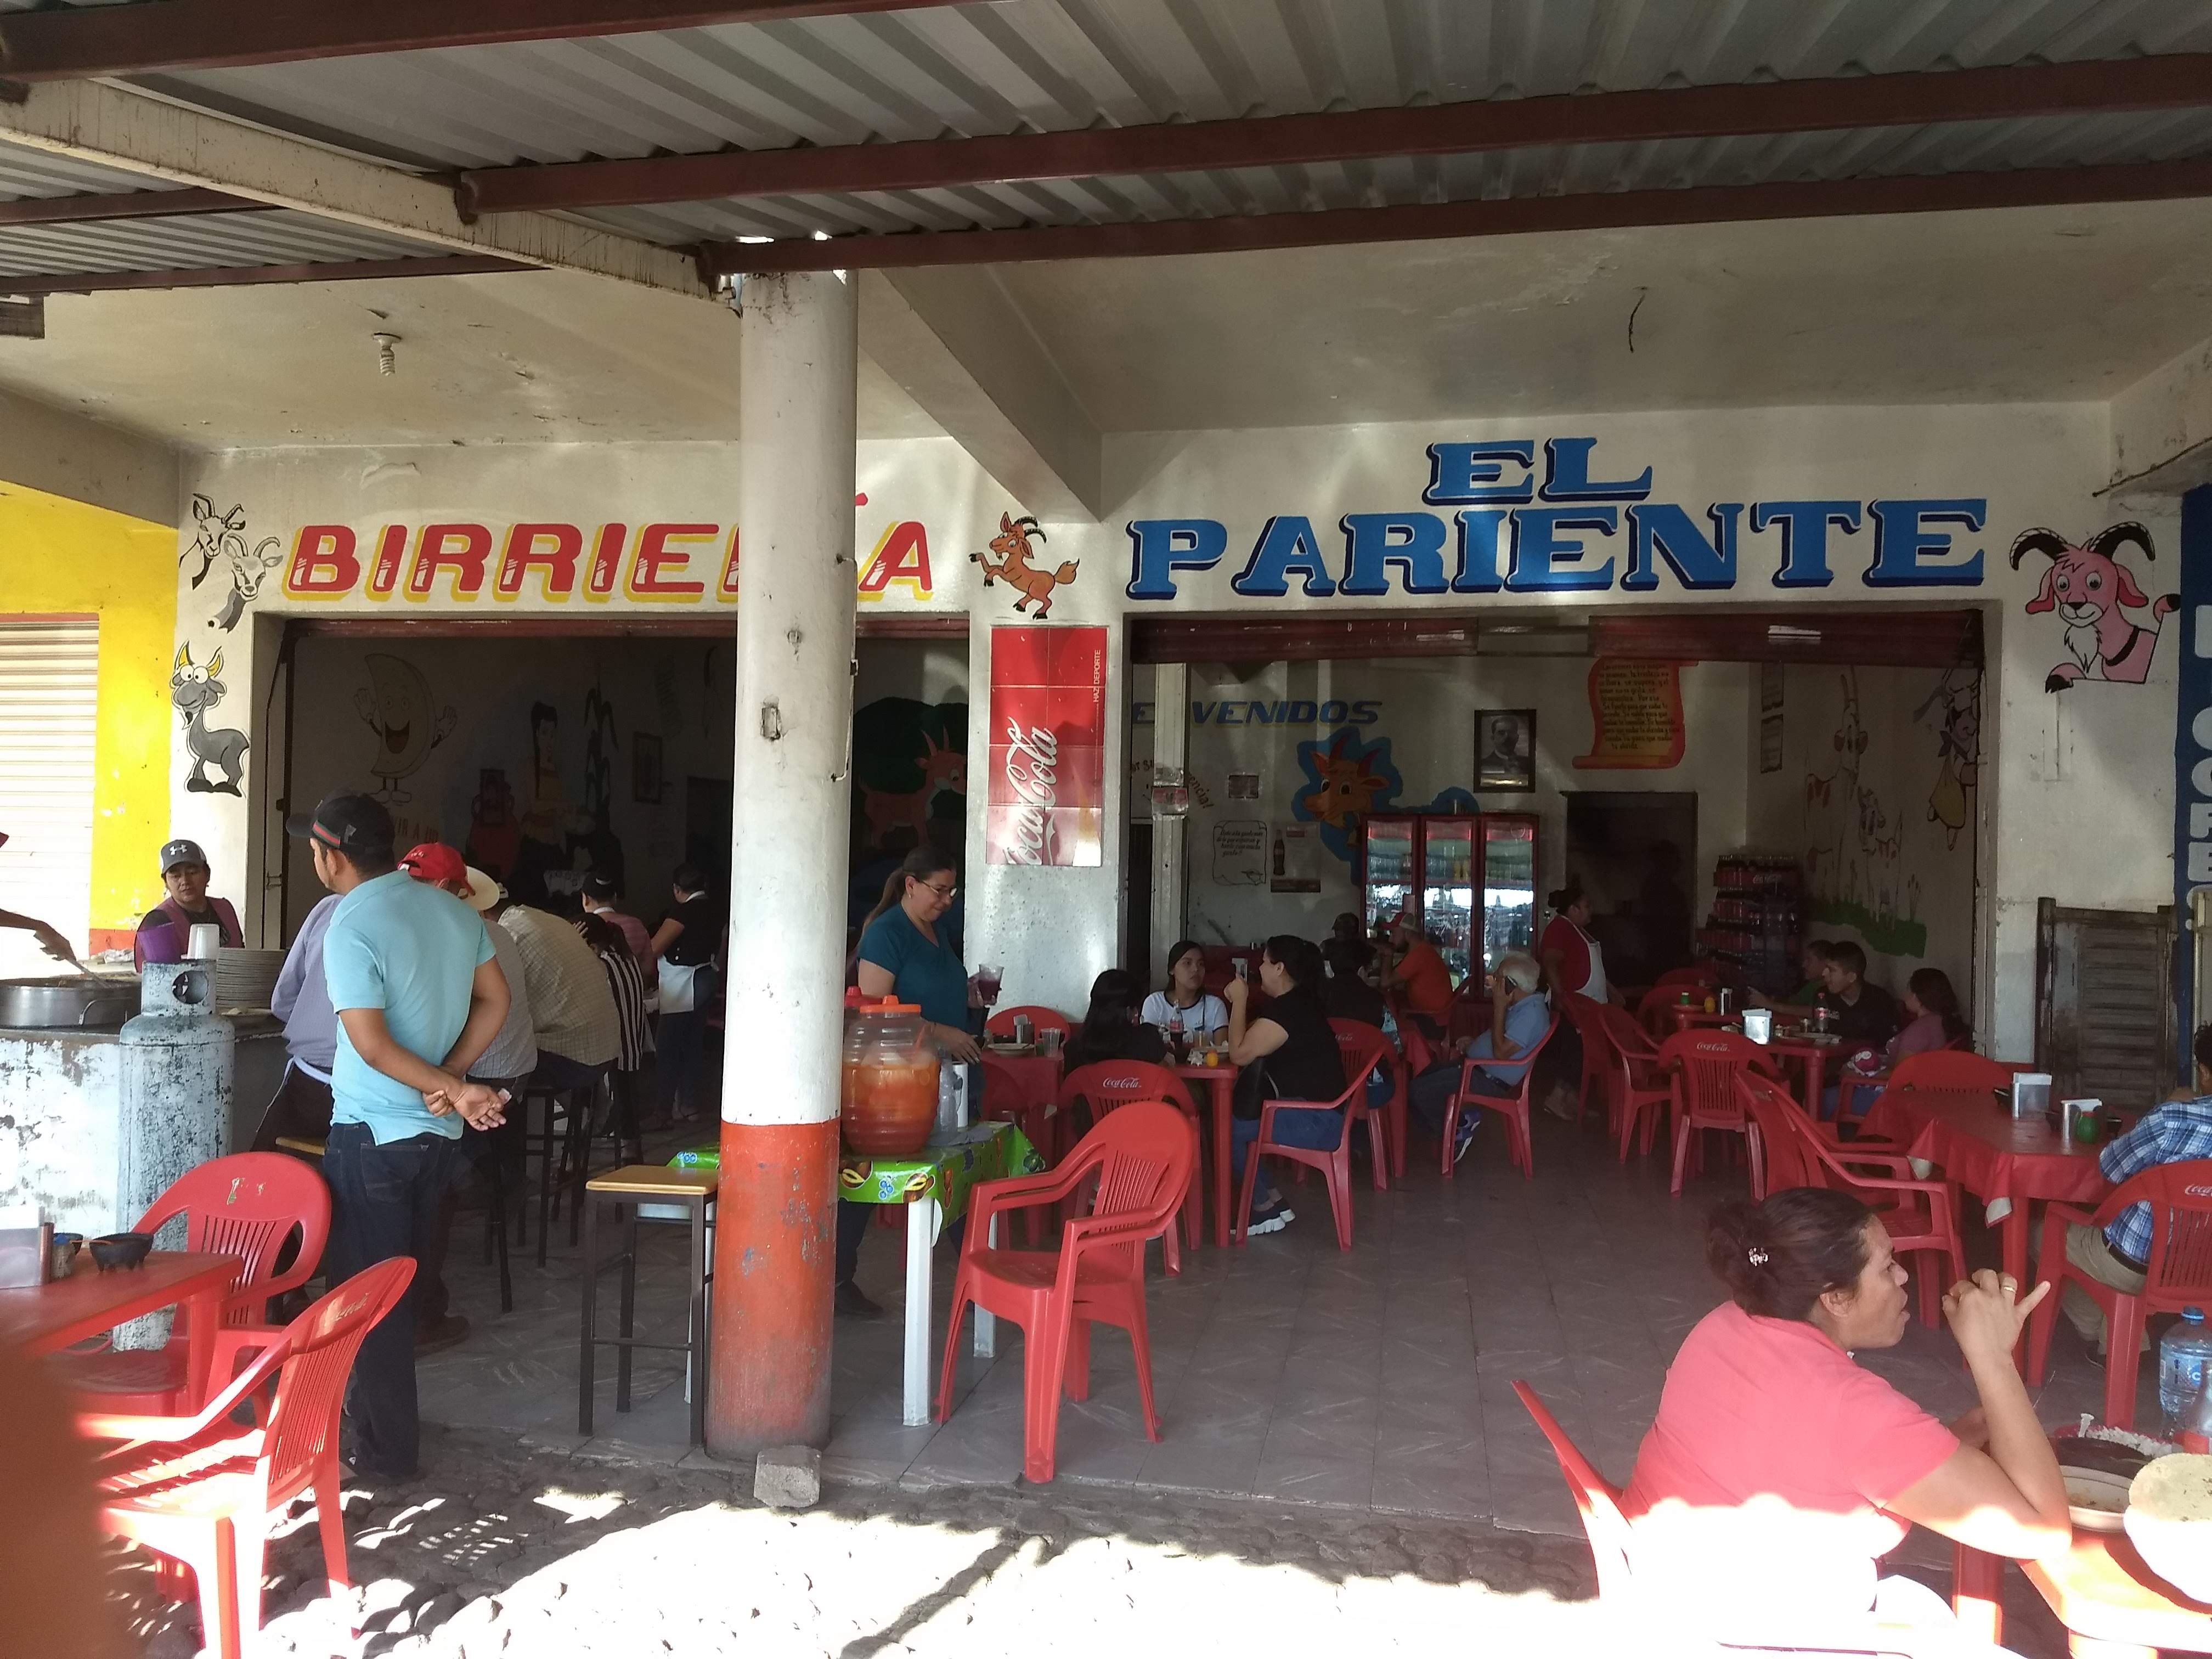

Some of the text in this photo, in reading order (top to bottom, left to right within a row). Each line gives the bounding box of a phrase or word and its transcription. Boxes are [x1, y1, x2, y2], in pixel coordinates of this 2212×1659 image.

[1421, 437, 1652, 505] EL
[282, 494, 934, 603] BIRRIEA
[1126, 499, 1988, 600] PARIENTE
[1132, 700, 1383, 727] EVENIDOS
[2185, 1184, 2212, 1197] Coca
